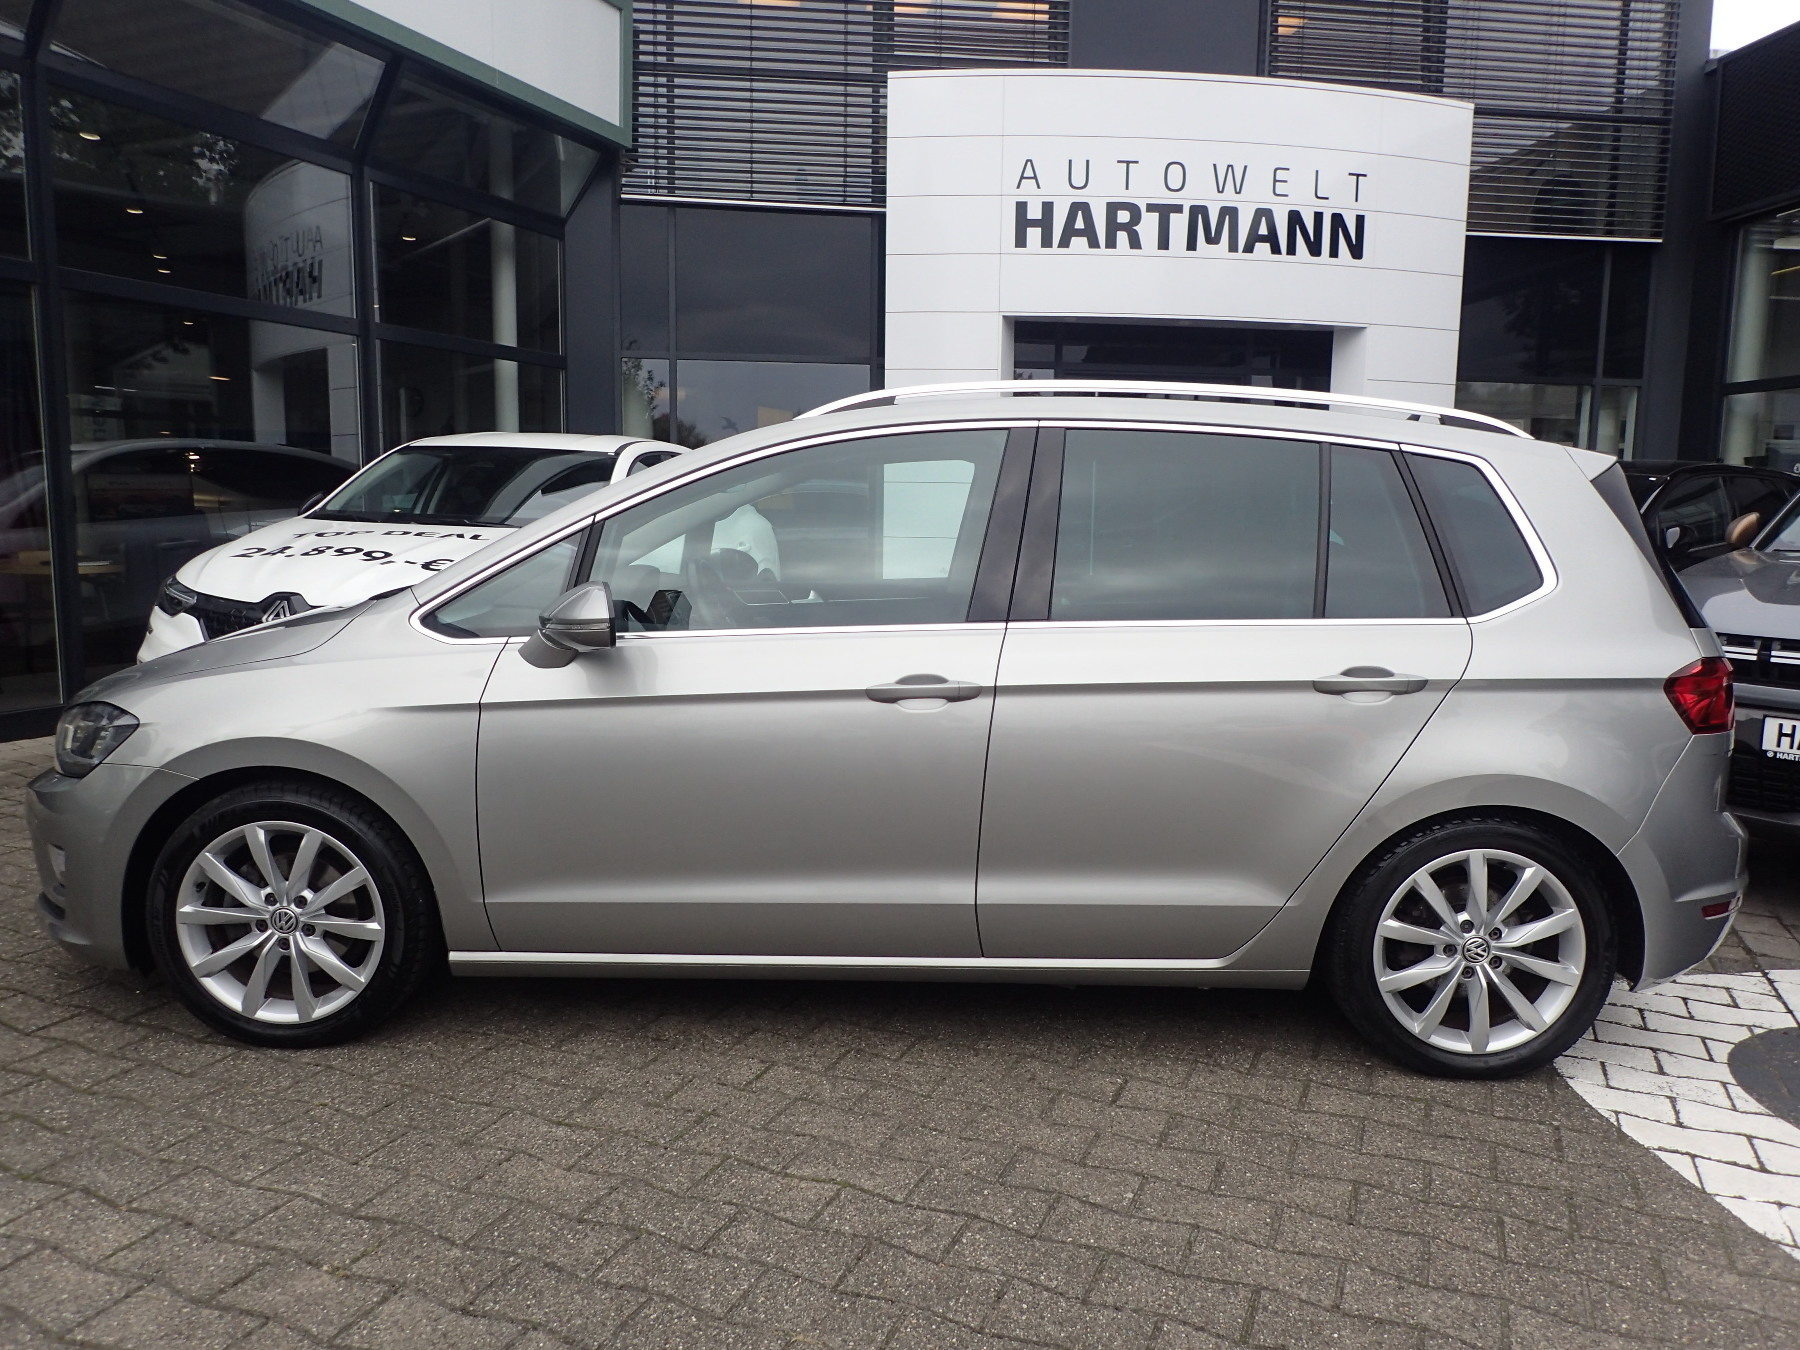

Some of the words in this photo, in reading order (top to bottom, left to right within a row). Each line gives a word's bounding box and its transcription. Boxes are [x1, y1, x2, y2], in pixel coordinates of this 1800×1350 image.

[1016, 159, 1368, 203] AUTOWELT
[1014, 200, 1366, 261] HARTMANN
[293, 530, 375, 540] TOP
[381, 530, 490, 541] DEAL
[1776, 722, 1800, 750] H
[1776, 752, 1800, 762] HART
